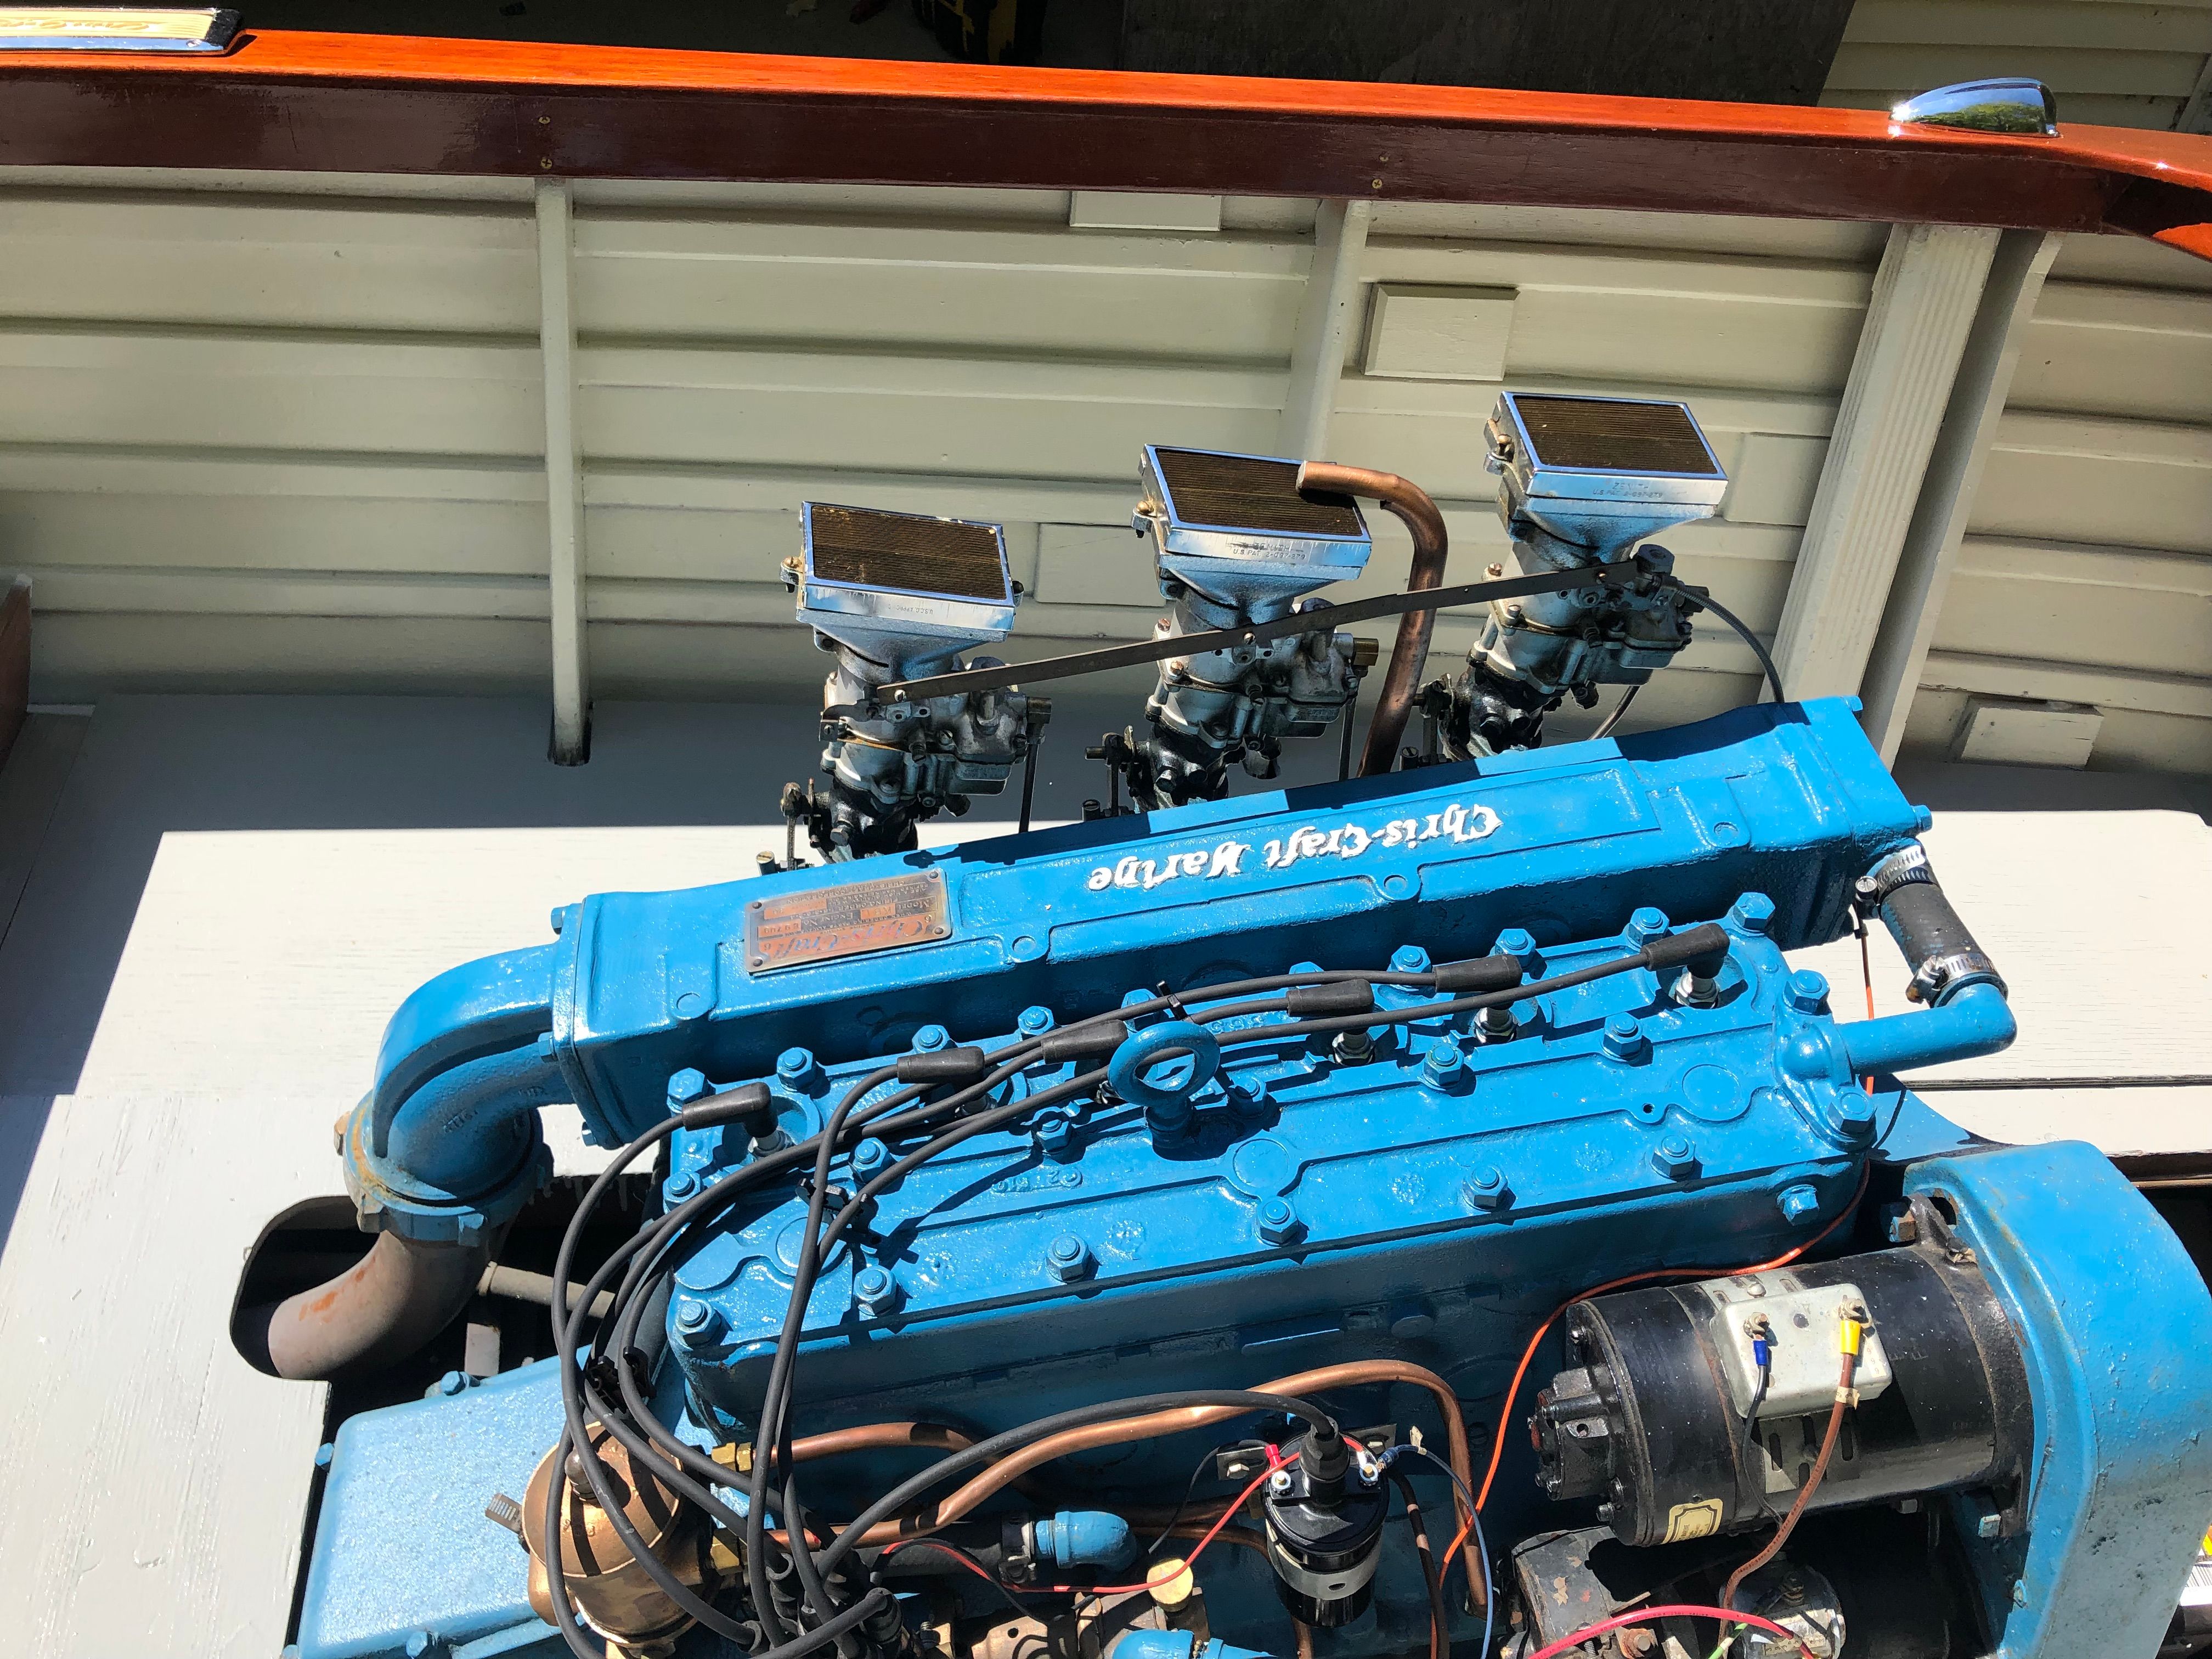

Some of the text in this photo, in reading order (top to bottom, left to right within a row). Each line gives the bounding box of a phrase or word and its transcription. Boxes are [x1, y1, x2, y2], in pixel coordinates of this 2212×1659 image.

[1265, 551, 1306, 560] 2-097-279
[1087, 803, 1504, 891] Chris-Craft Marine
[862, 906, 890, 917] KBL
